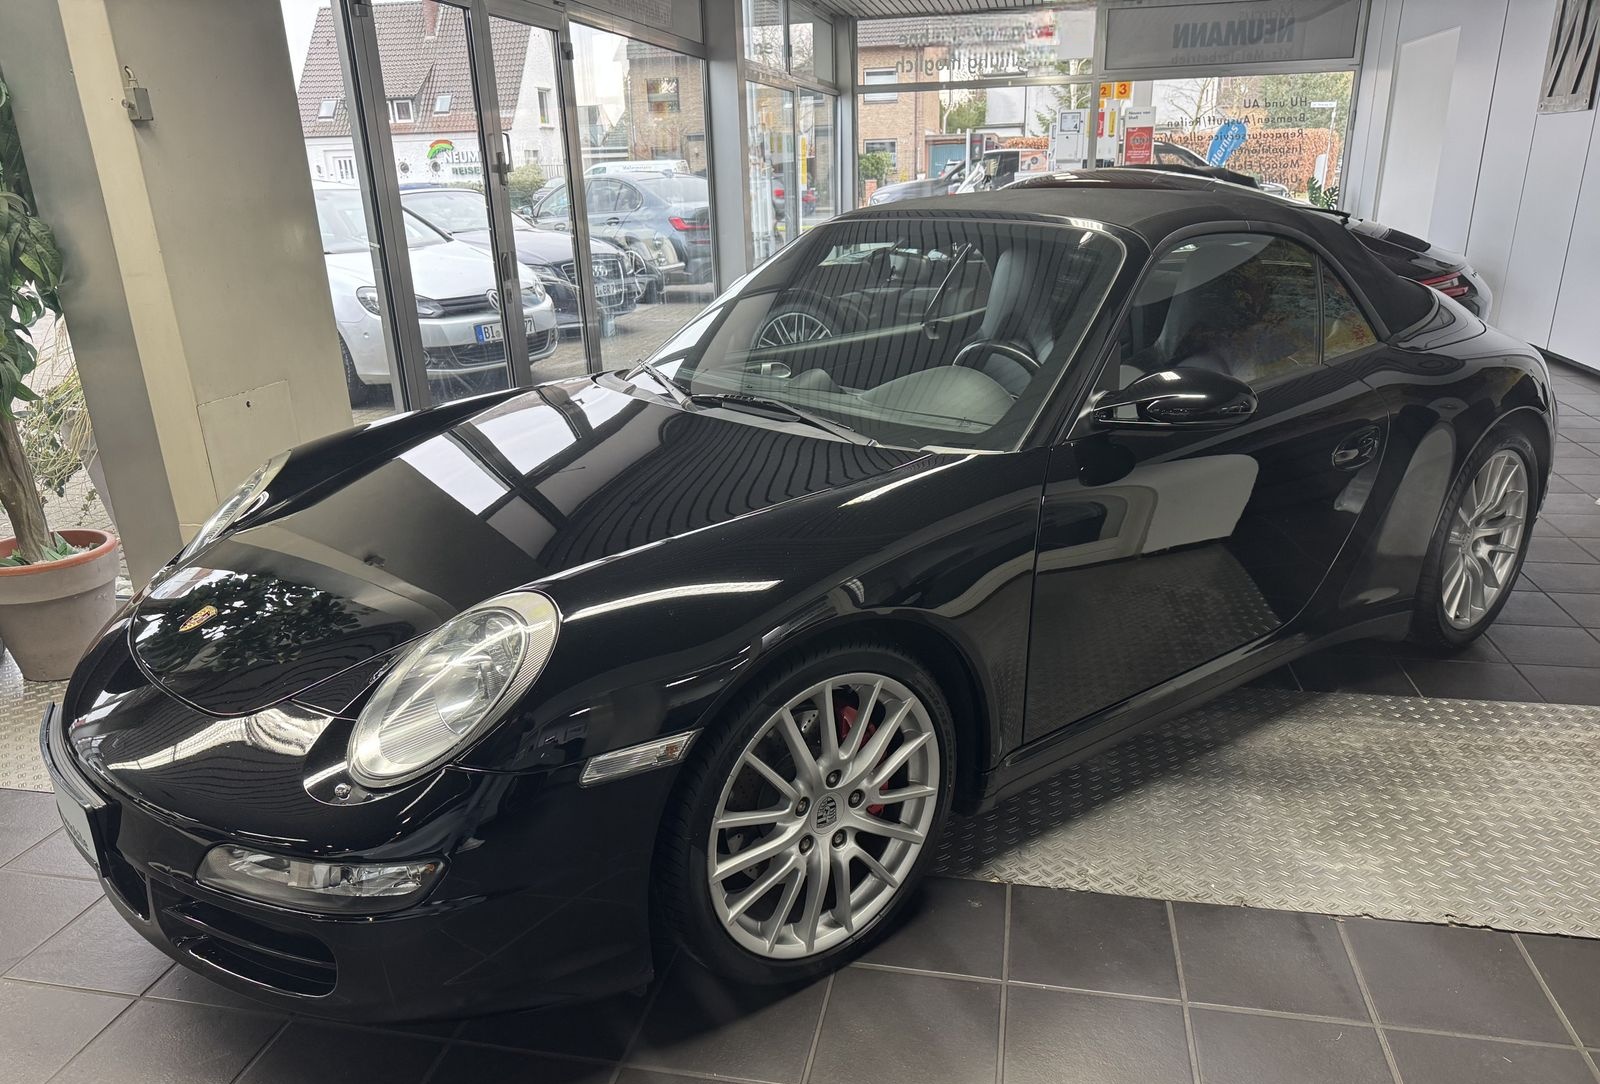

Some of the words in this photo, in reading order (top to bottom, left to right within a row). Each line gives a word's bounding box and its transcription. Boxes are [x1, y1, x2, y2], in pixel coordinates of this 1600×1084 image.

[1101, 86, 1107, 95] 2
[1119, 83, 1128, 95] 3
[484, 326, 496, 339] BI
